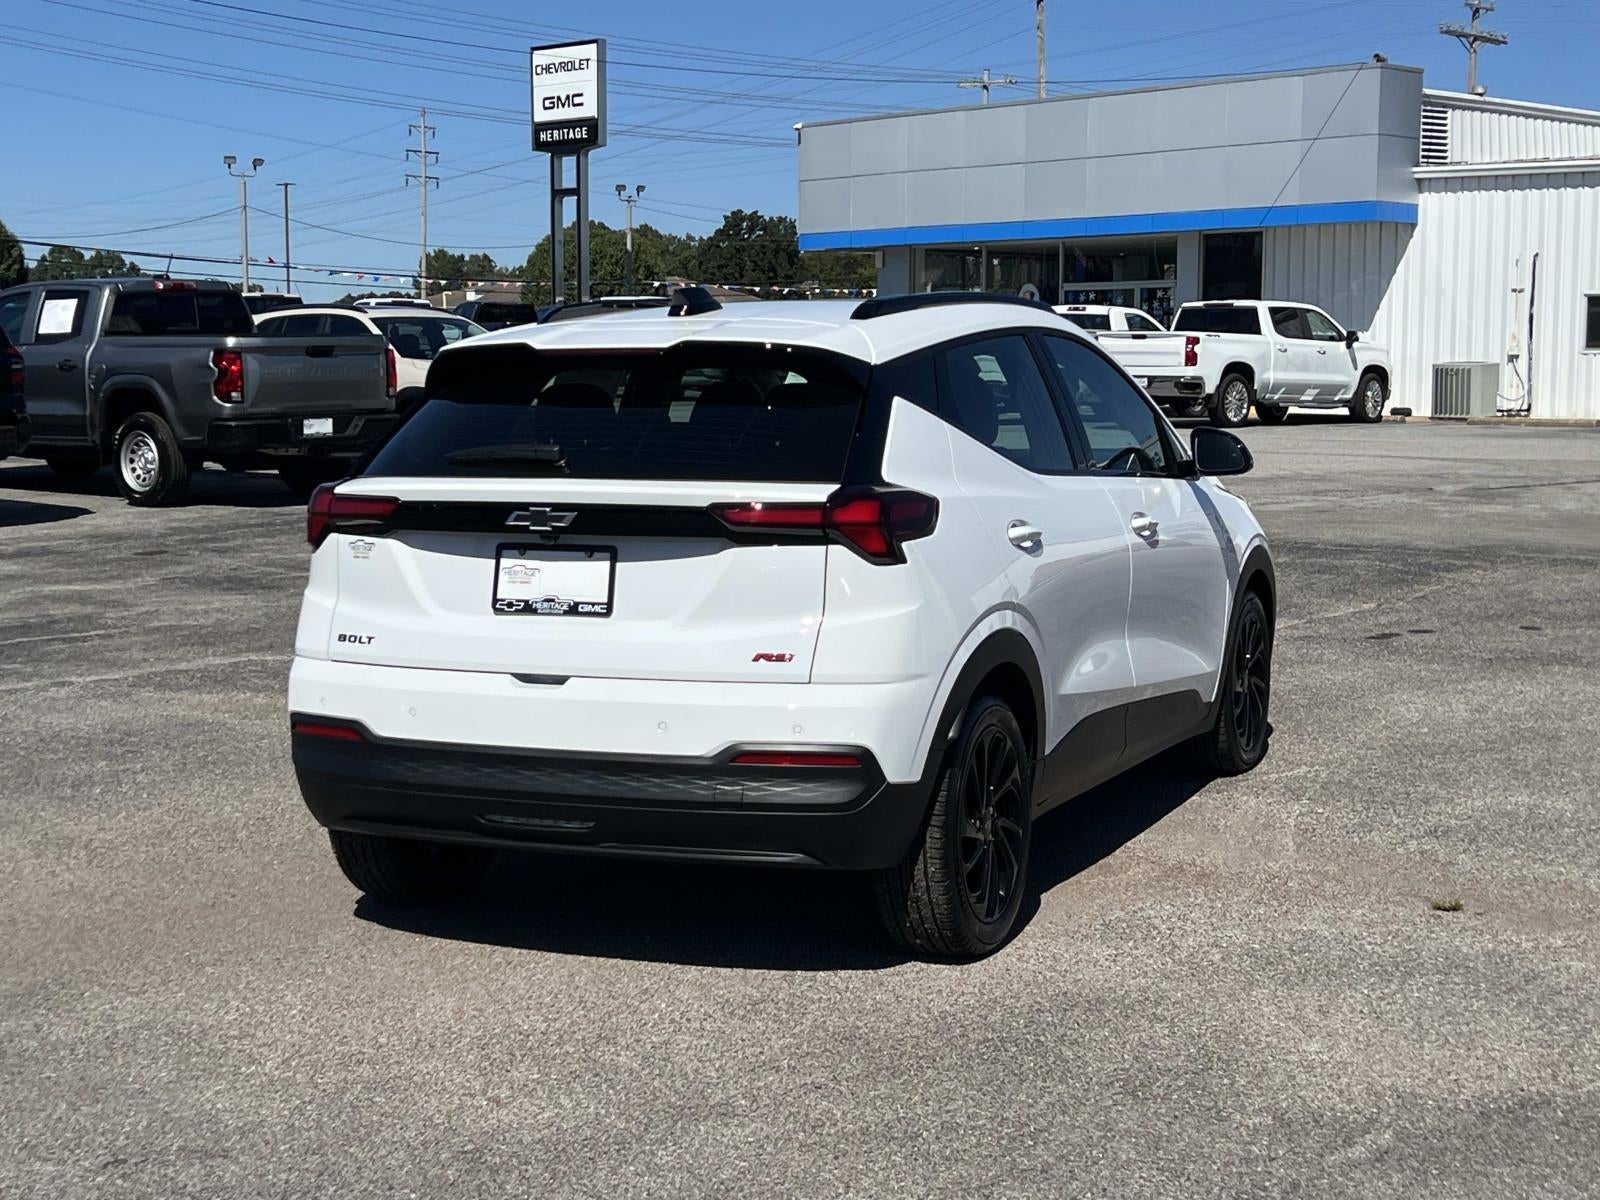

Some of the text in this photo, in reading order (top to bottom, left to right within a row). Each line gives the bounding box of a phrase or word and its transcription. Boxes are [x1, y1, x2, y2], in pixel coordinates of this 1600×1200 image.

[535, 58, 591, 76] CHEVROLET
[542, 92, 584, 111] GMC
[540, 126, 588, 142] HERITAGE
[532, 601, 570, 611] HERITAGE
[577, 603, 608, 613] GMC
[337, 633, 376, 645] BOLT
